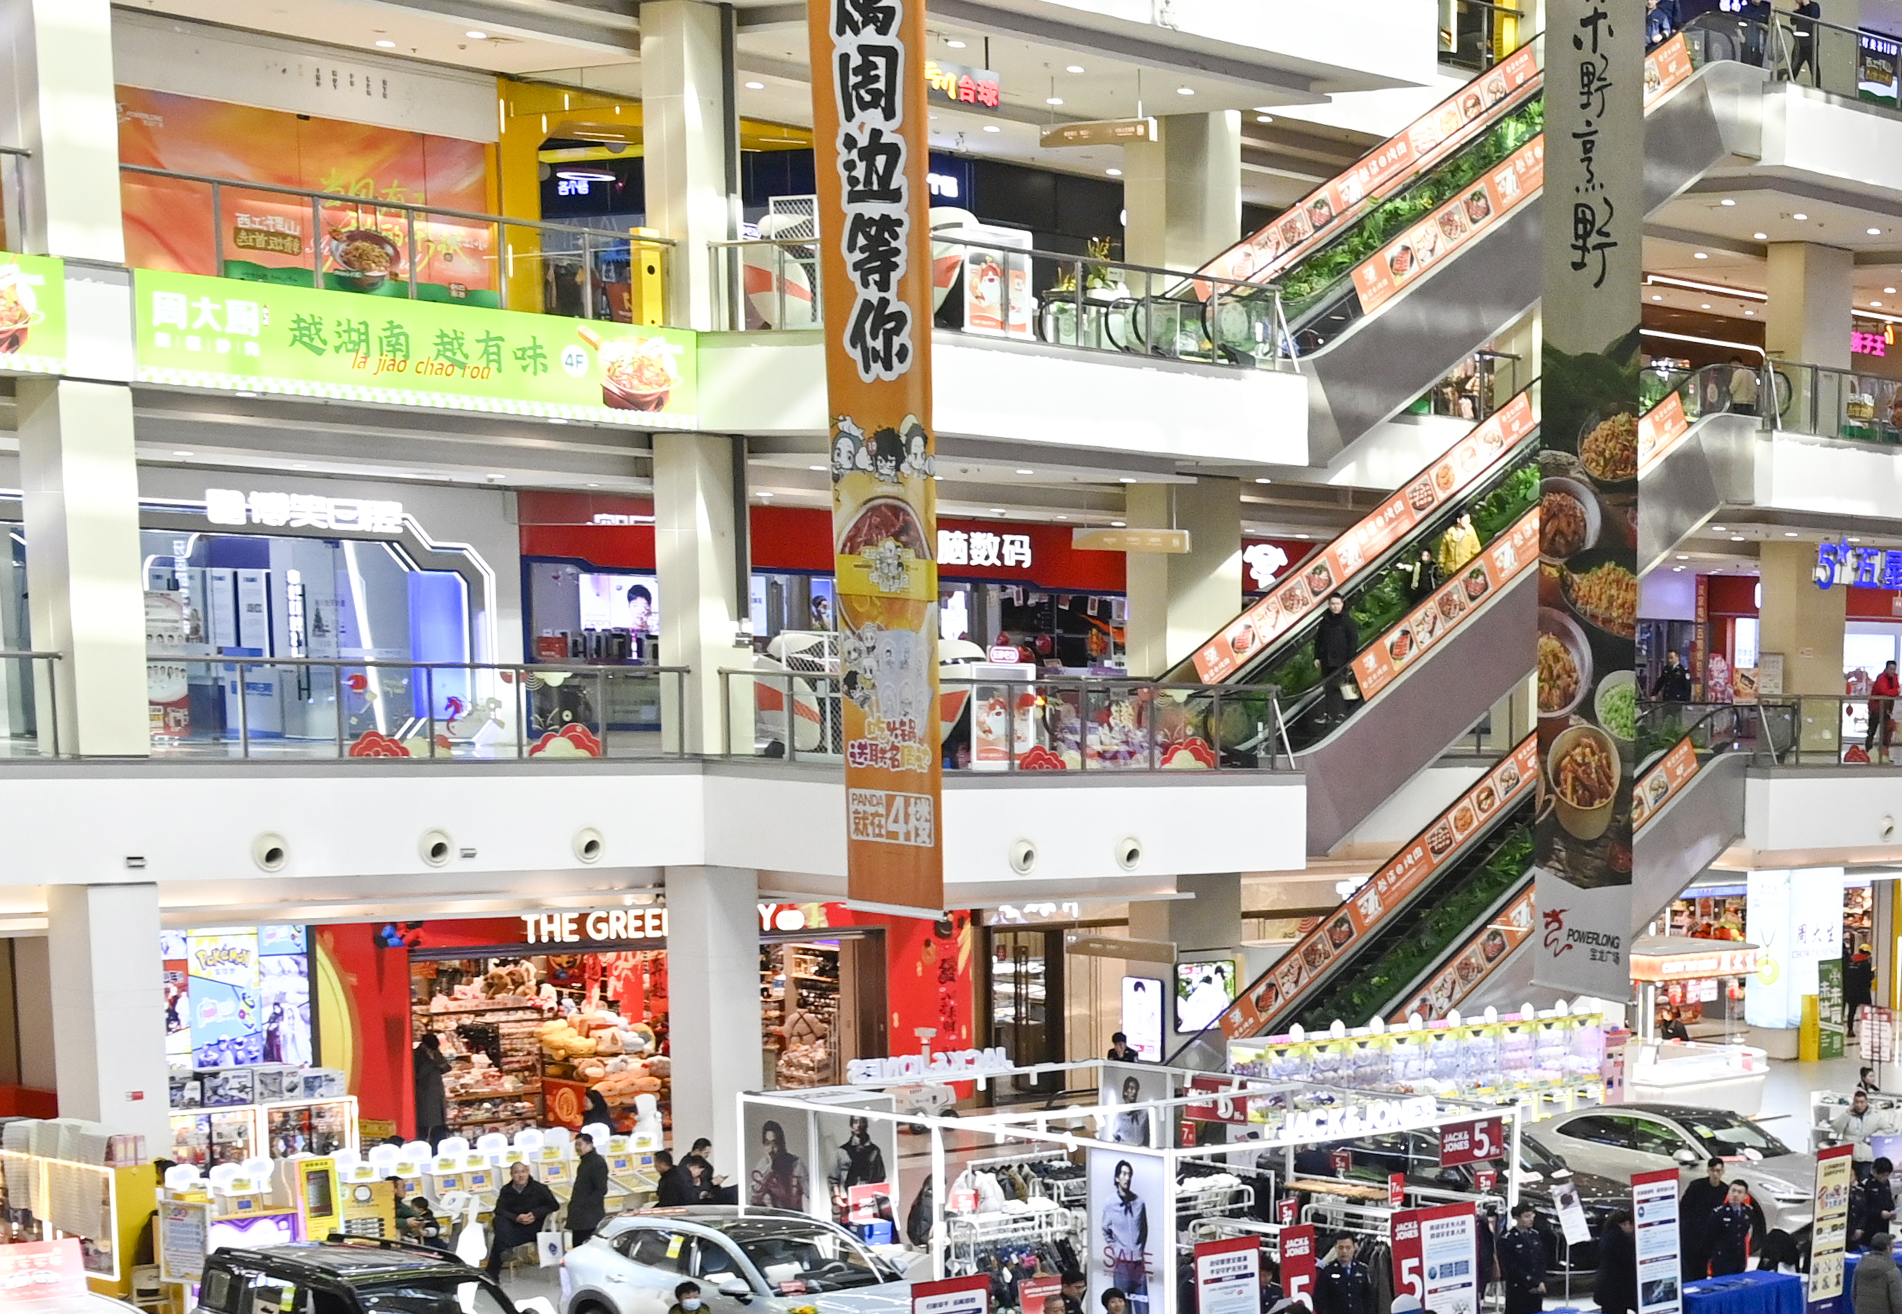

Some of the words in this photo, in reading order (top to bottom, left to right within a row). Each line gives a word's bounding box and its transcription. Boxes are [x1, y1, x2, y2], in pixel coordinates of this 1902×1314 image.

[288, 313, 411, 361] 越湖南
[432, 328, 549, 377] 越有味
[352, 350, 366, 370] la
[374, 353, 407, 376] jiao
[415, 356, 455, 377] chao
[564, 354, 585, 370] 4F
[520, 912, 581, 945] THE
[757, 903, 777, 932] Y
[1567, 928, 1621, 950] POWERLONG
[1796, 922, 1835, 944] 周大生
[1277, 1096, 1438, 1140] JACK&JONES
[1443, 1131, 1470, 1143] JACK&
[1473, 1121, 1490, 1157] 5
[1443, 1141, 1470, 1153] JONES
[1395, 1221, 1419, 1232] JACK&
[1395, 1230, 1420, 1241] JONES
[1285, 1237, 1309, 1248] JACK&
[1285, 1246, 1310, 1258] JONES
[1103, 1246, 1154, 1275] SALE
[1402, 1258, 1423, 1298] 5
